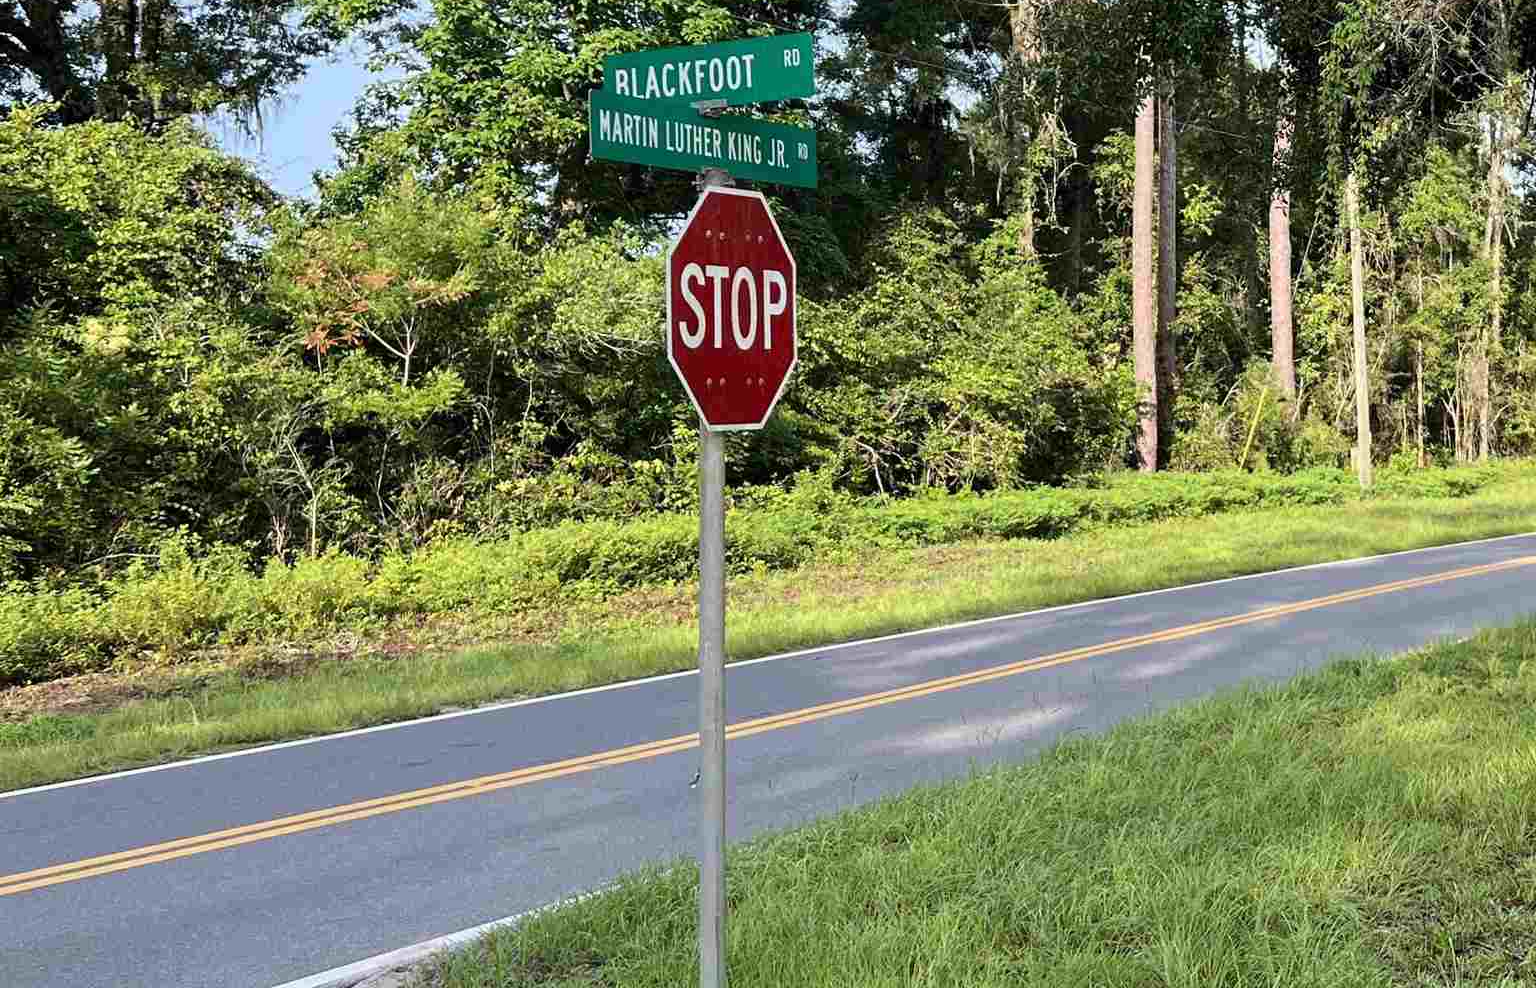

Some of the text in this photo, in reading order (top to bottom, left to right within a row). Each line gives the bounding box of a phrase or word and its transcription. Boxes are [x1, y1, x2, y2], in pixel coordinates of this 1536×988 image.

[615, 48, 801, 100] BLACKFOOT RD
[599, 109, 809, 168] MARTIN LUTHER KING JR. RD
[678, 262, 788, 351] STOP
